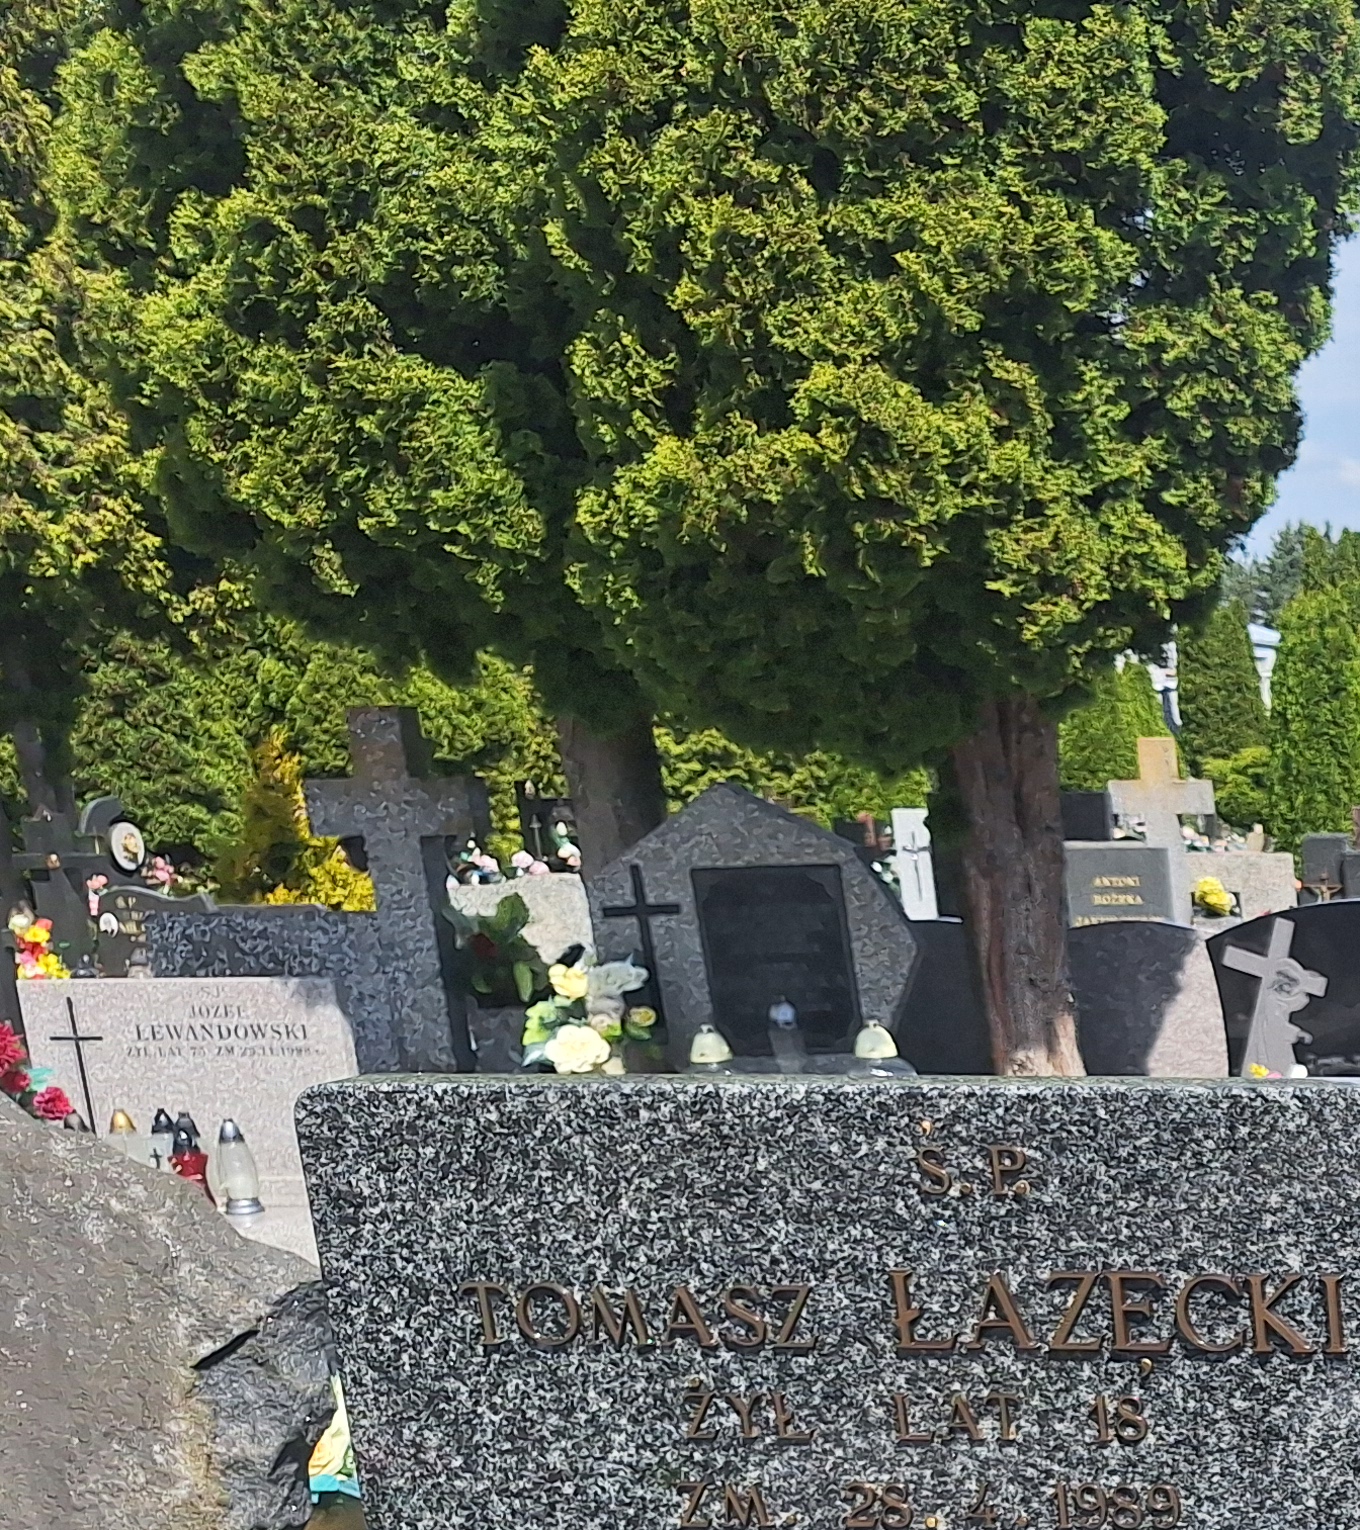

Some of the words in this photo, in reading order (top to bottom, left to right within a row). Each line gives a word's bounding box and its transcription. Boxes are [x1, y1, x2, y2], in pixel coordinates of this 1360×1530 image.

[135, 1022, 308, 1042] LEWANDOWSKI
[459, 1281, 818, 1348] TOMASZ
[889, 1268, 1349, 1376] ŁAZĘCKI
[684, 1376, 815, 1442] ŻYŁ
[894, 1392, 1020, 1443] LAT
[1092, 1395, 1148, 1443] 18
[675, 1481, 797, 1529] ZM.
[1053, 1483, 1182, 1530] 1989
